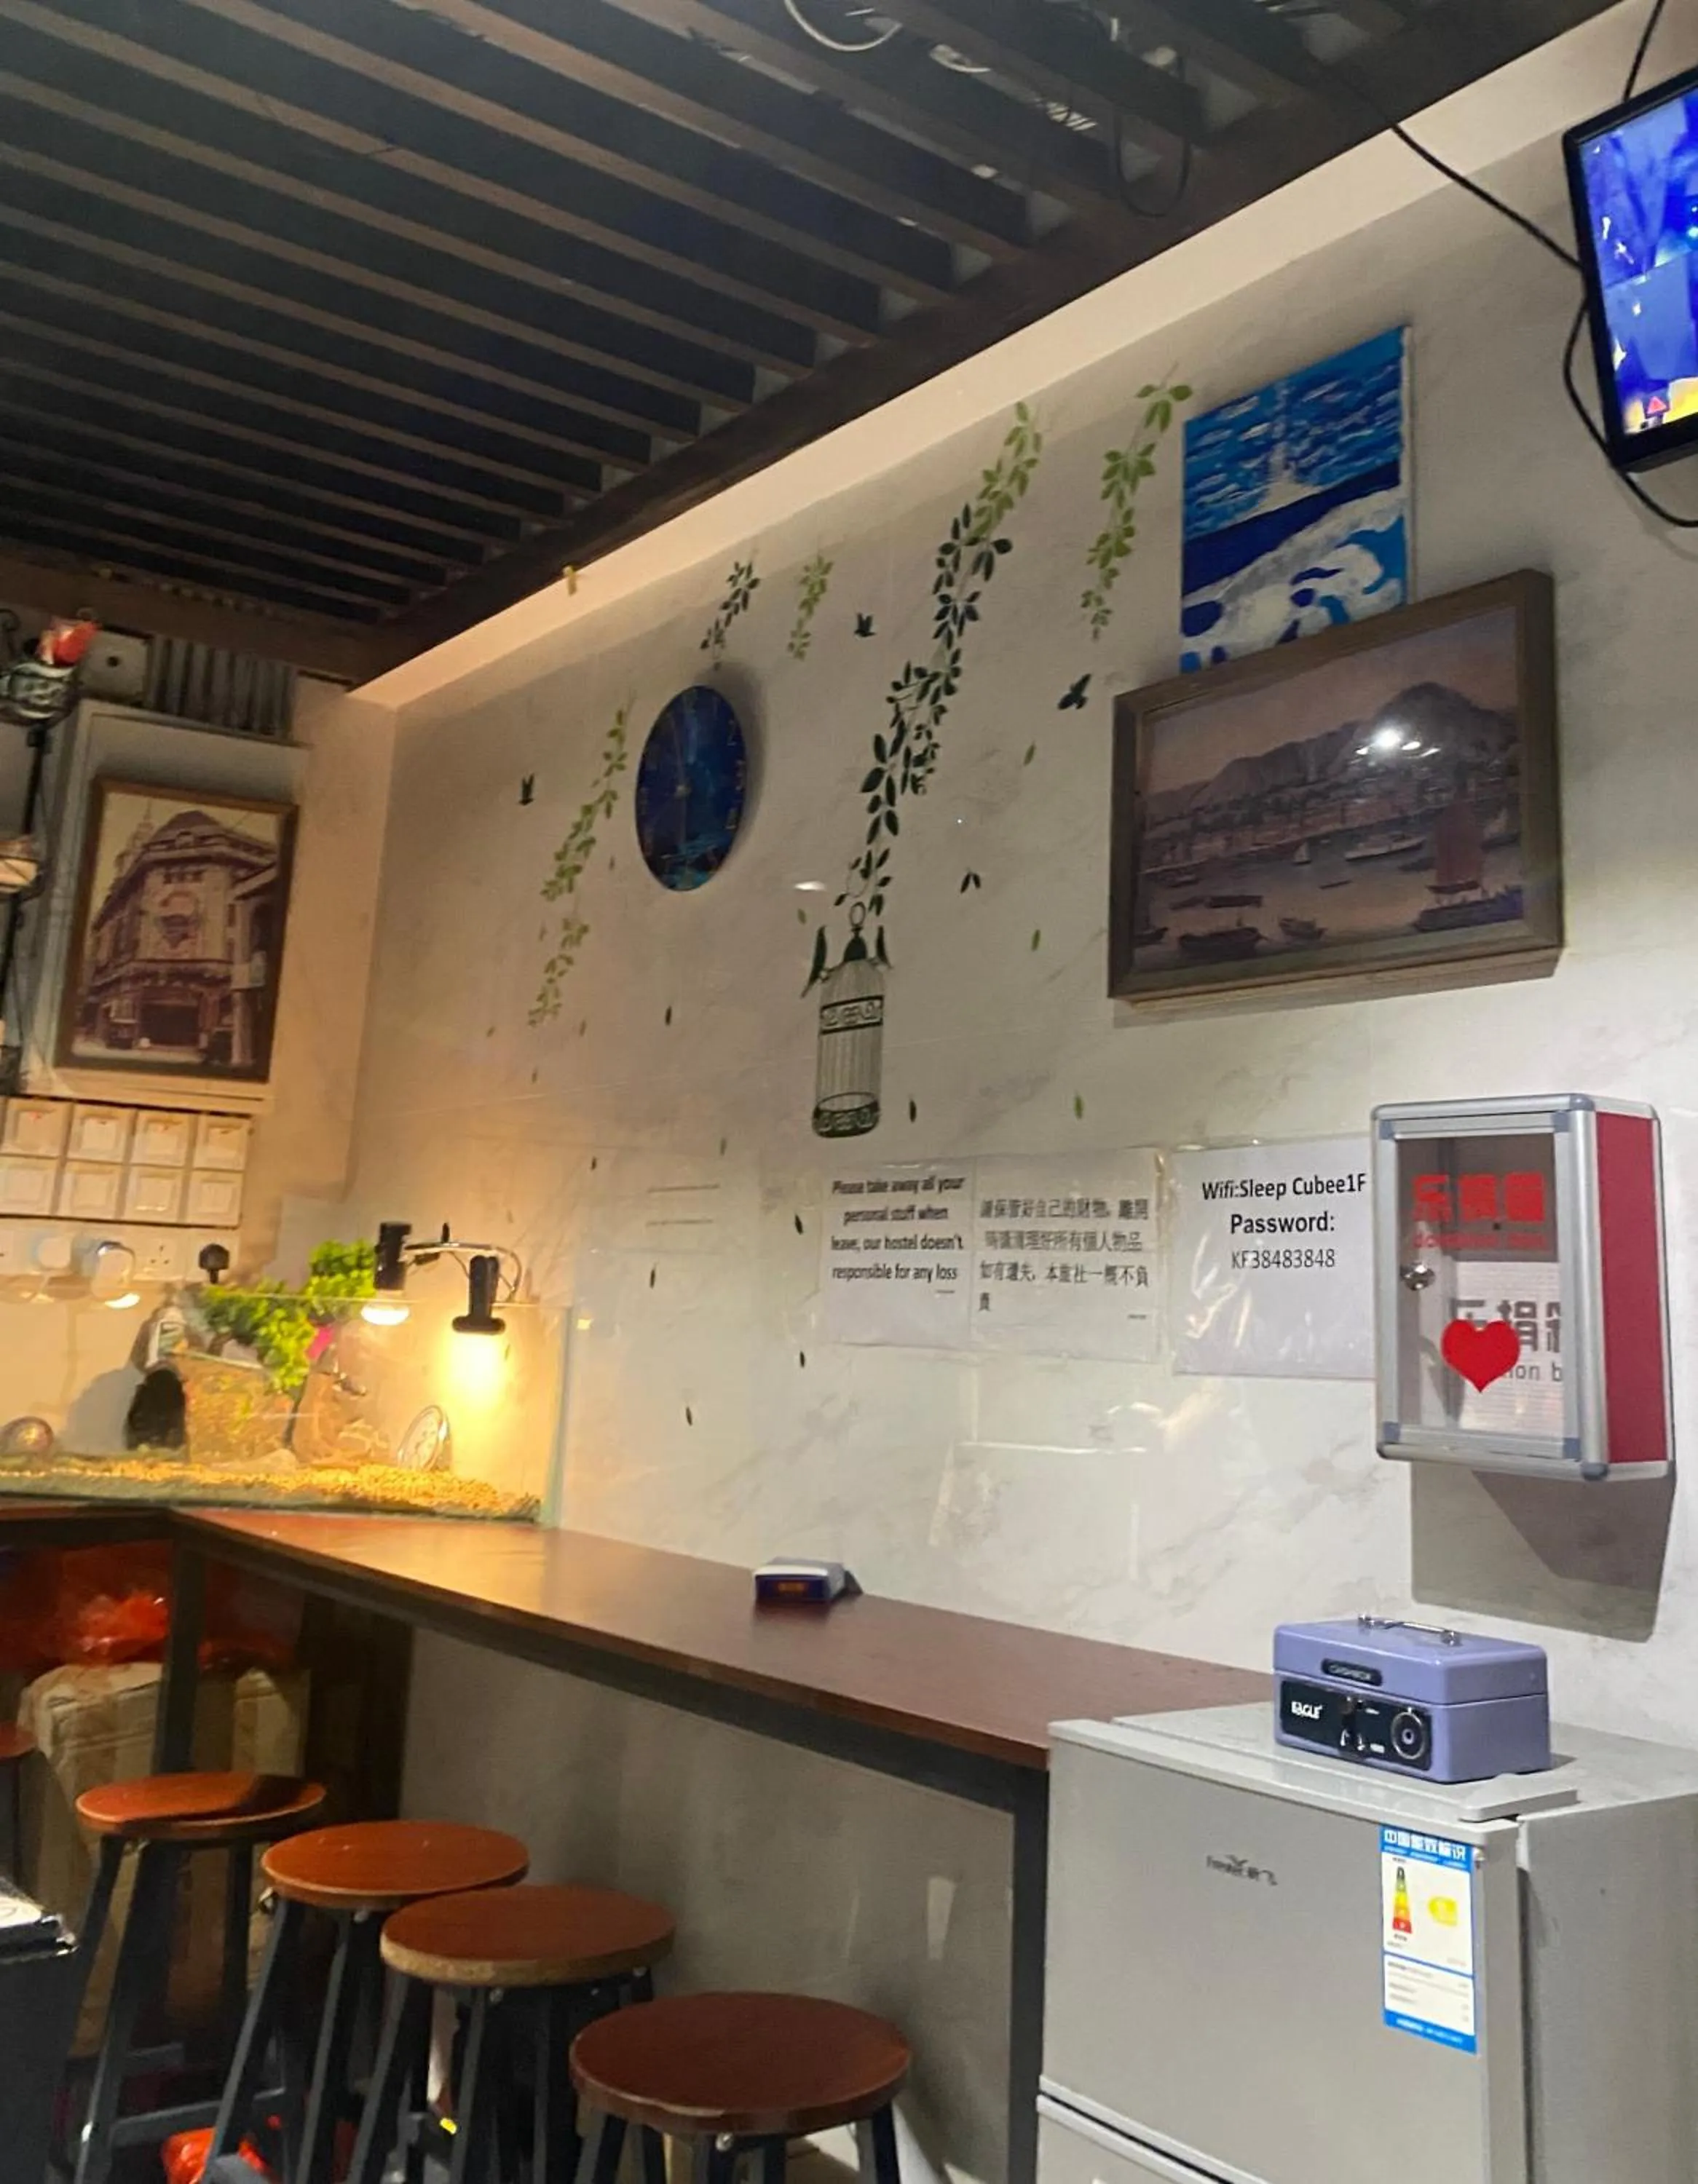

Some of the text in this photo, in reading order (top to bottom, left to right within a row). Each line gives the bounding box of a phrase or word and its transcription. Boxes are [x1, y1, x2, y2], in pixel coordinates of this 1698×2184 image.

[1201, 1173, 1367, 1200] Wifi:Sleep Cubee1F
[1230, 1211, 1335, 1235] Password:
[863, 1239, 882, 1251] our
[884, 1234, 917, 1250] hostel
[920, 1233, 964, 1250] doesn't
[1231, 1248, 1336, 1270] KF38483848
[832, 1263, 957, 1283] responsible for any loss
